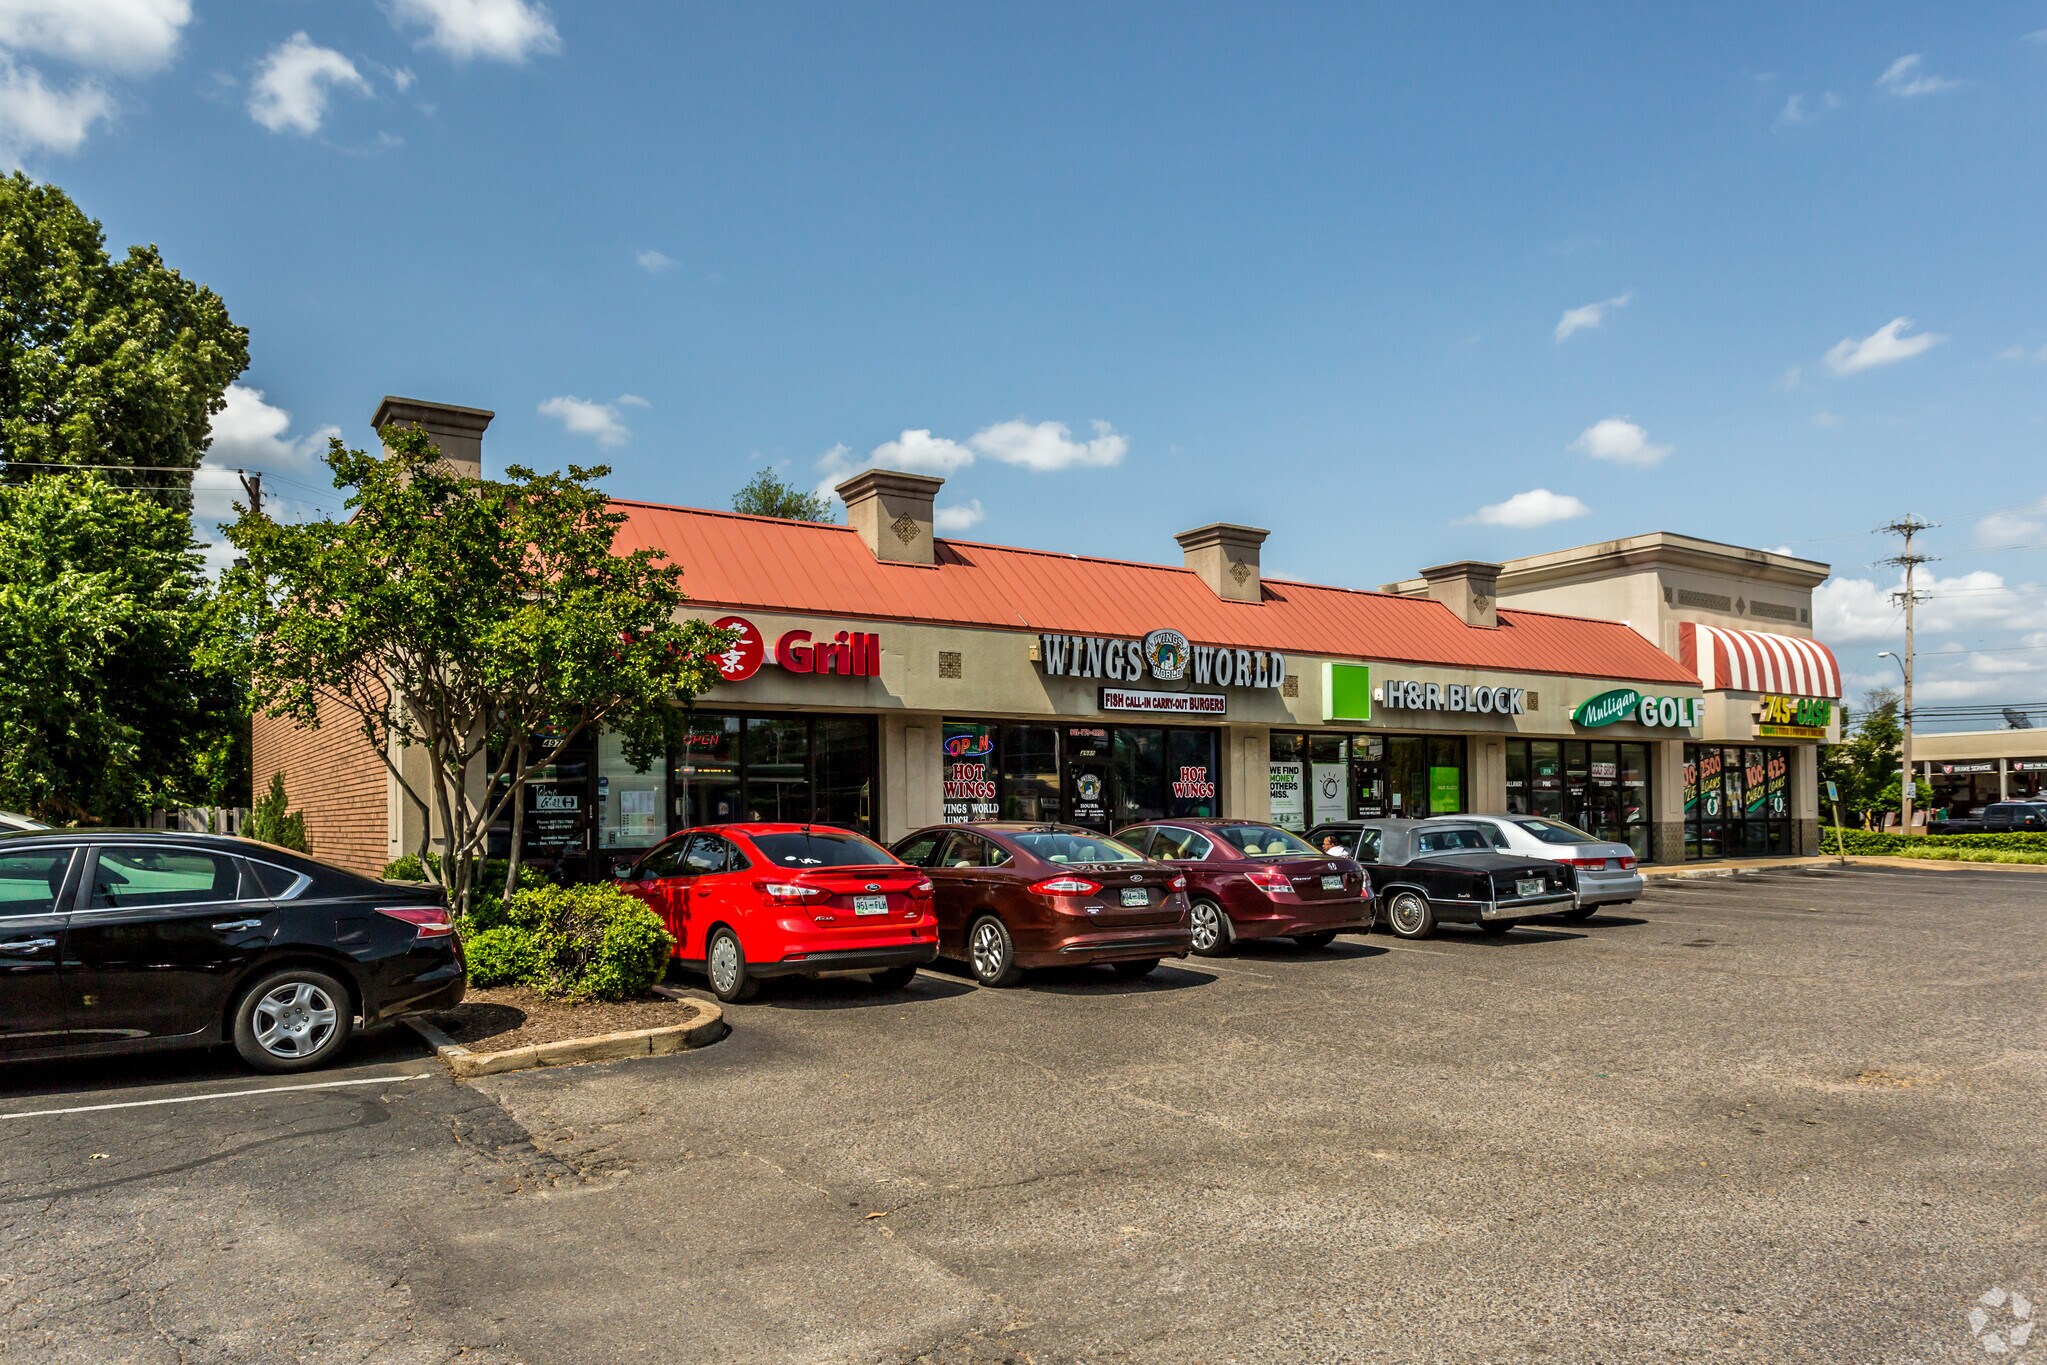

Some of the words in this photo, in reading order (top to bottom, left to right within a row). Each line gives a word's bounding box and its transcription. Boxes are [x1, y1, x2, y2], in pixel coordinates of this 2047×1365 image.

[1153, 632, 1184, 646] WINGS
[774, 629, 880, 676] Grill
[1041, 634, 1142, 682] WINGS
[1192, 645, 1286, 688] WORLD
[1153, 666, 1183, 679] WORLD
[1105, 692, 1124, 707] FISH
[1125, 695, 1151, 709] CALL-IN
[1152, 696, 1189, 710] CARRY-OUT
[1189, 696, 1225, 711] BURGERS
[1384, 680, 1441, 711] H&R
[1446, 684, 1525, 715] BLOCK
[1584, 691, 1636, 727] Mulligan
[1637, 695, 1705, 728] GOLF
[1762, 695, 1831, 727] 745-CASH
[543, 739, 563, 747] 497
[682, 734, 720, 746] OPEN
[949, 734, 989, 757] OPN
[952, 763, 985, 781] HOT
[1180, 766, 1207, 782] HOT
[1270, 766, 1281, 774] WE
[1282, 766, 1299, 774] FIND
[1700, 755, 1721, 779] 2500
[1767, 757, 1786, 779] 425
[531, 784, 558, 798] Tokyo
[943, 781, 996, 799] WINGS
[1172, 781, 1215, 798] WINGS
[1270, 782, 1298, 790] OTHERS
[1700, 776, 1721, 794] LOANS
[1745, 785, 1765, 805] CHECK
[1768, 776, 1786, 793] LOANS
[971, 803, 1000, 814] WORLD
[944, 816, 969, 824] LUNCH
[856, 901, 887, 910] 951-FLH
